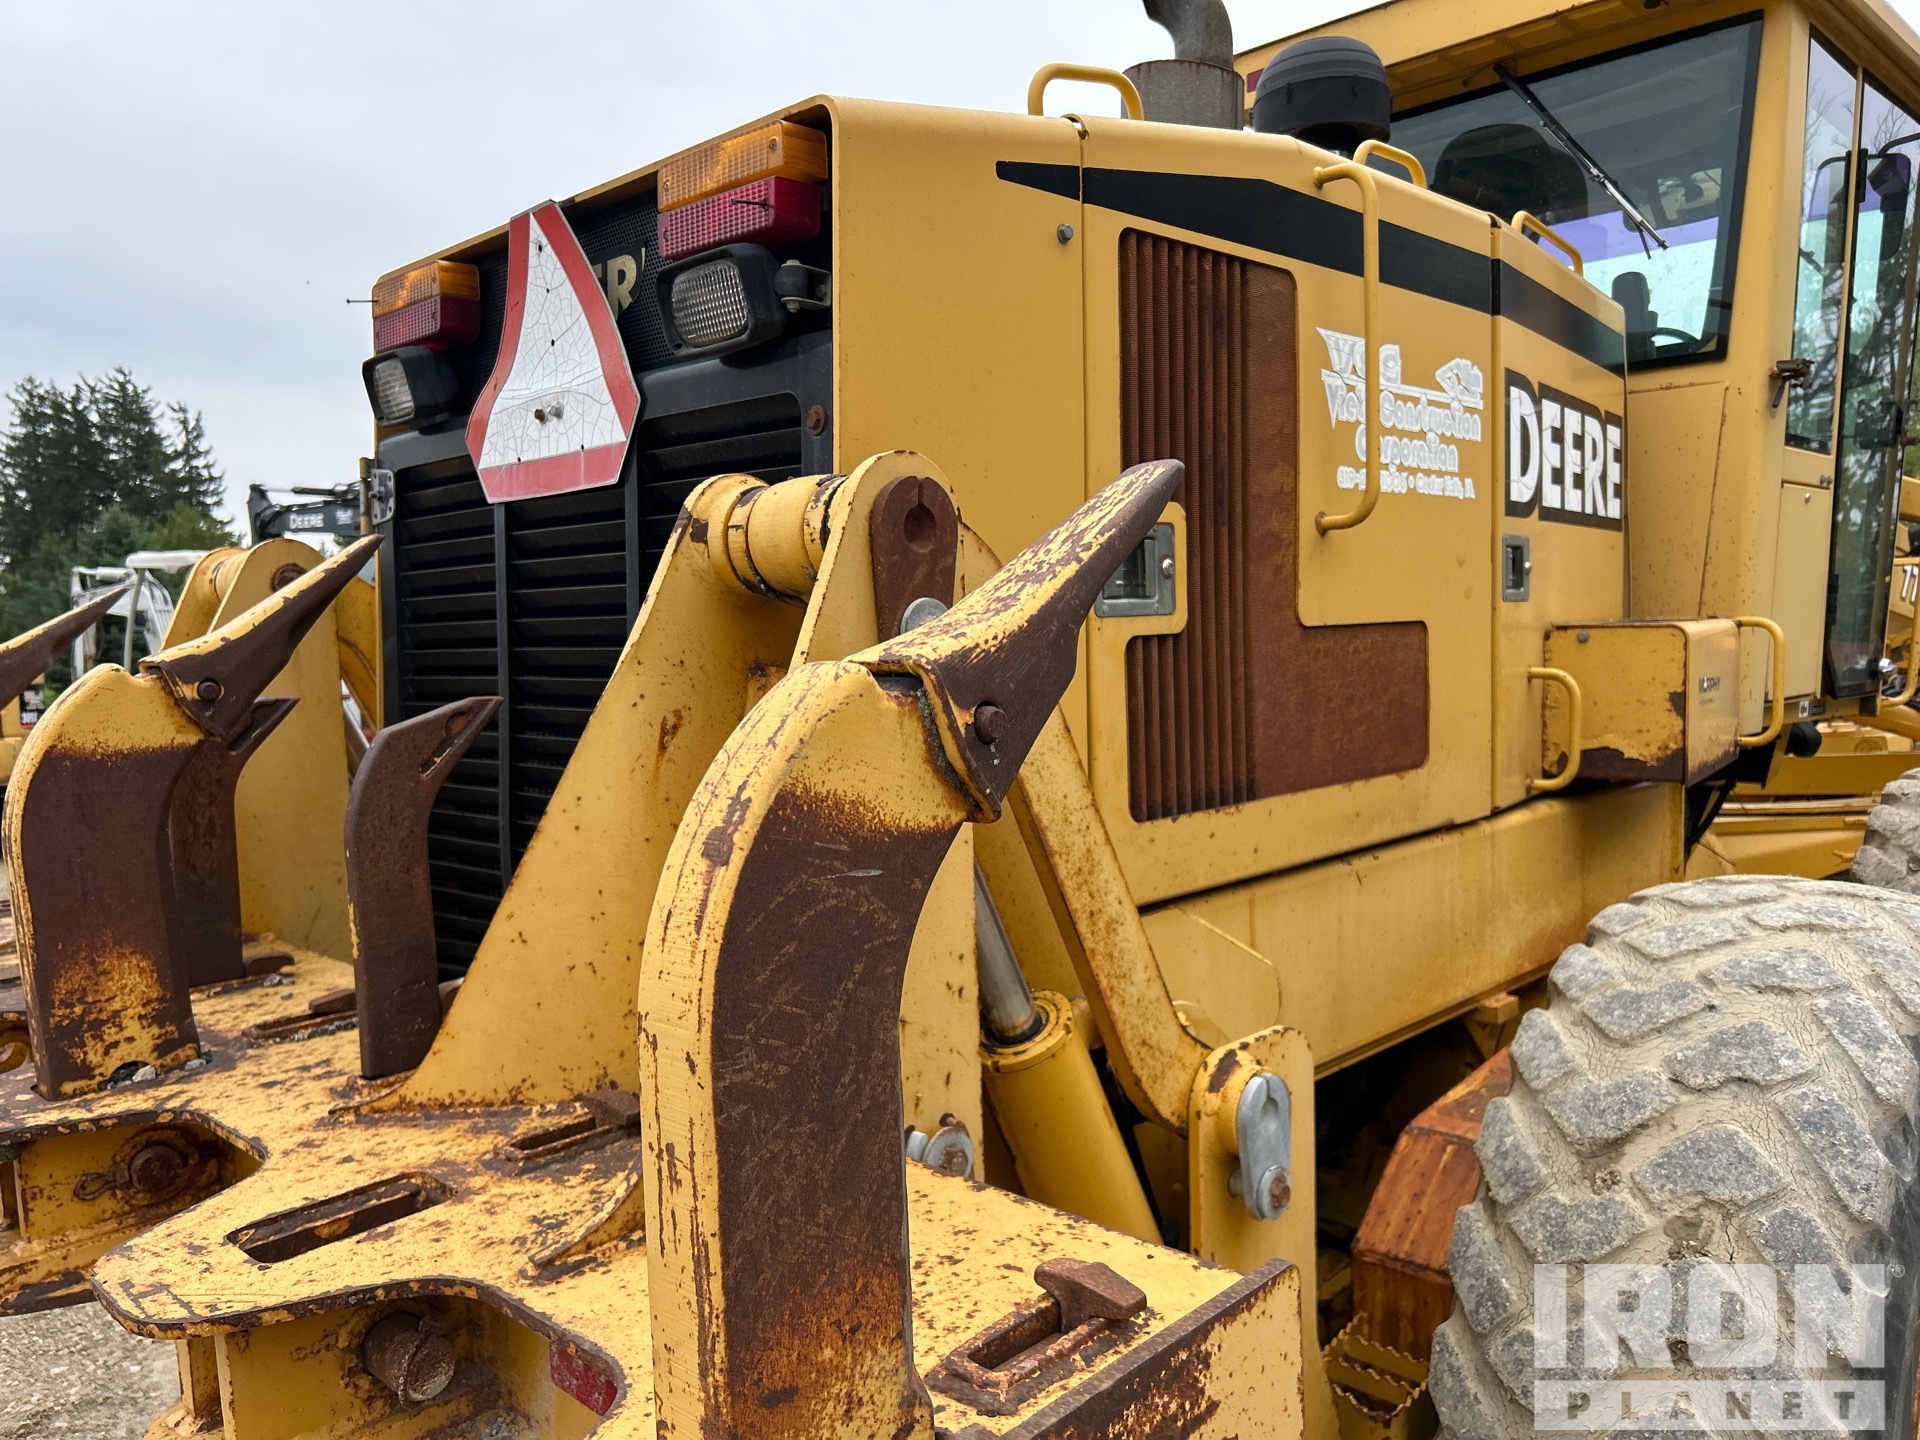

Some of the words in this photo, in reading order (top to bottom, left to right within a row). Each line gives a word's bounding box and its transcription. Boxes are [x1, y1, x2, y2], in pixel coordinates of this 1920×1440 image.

[1379, 388, 1482, 442] Construction
[1355, 423, 1459, 473] Crporation
[1509, 384, 1622, 520] DEERE
[289, 512, 325, 530] DEERE
